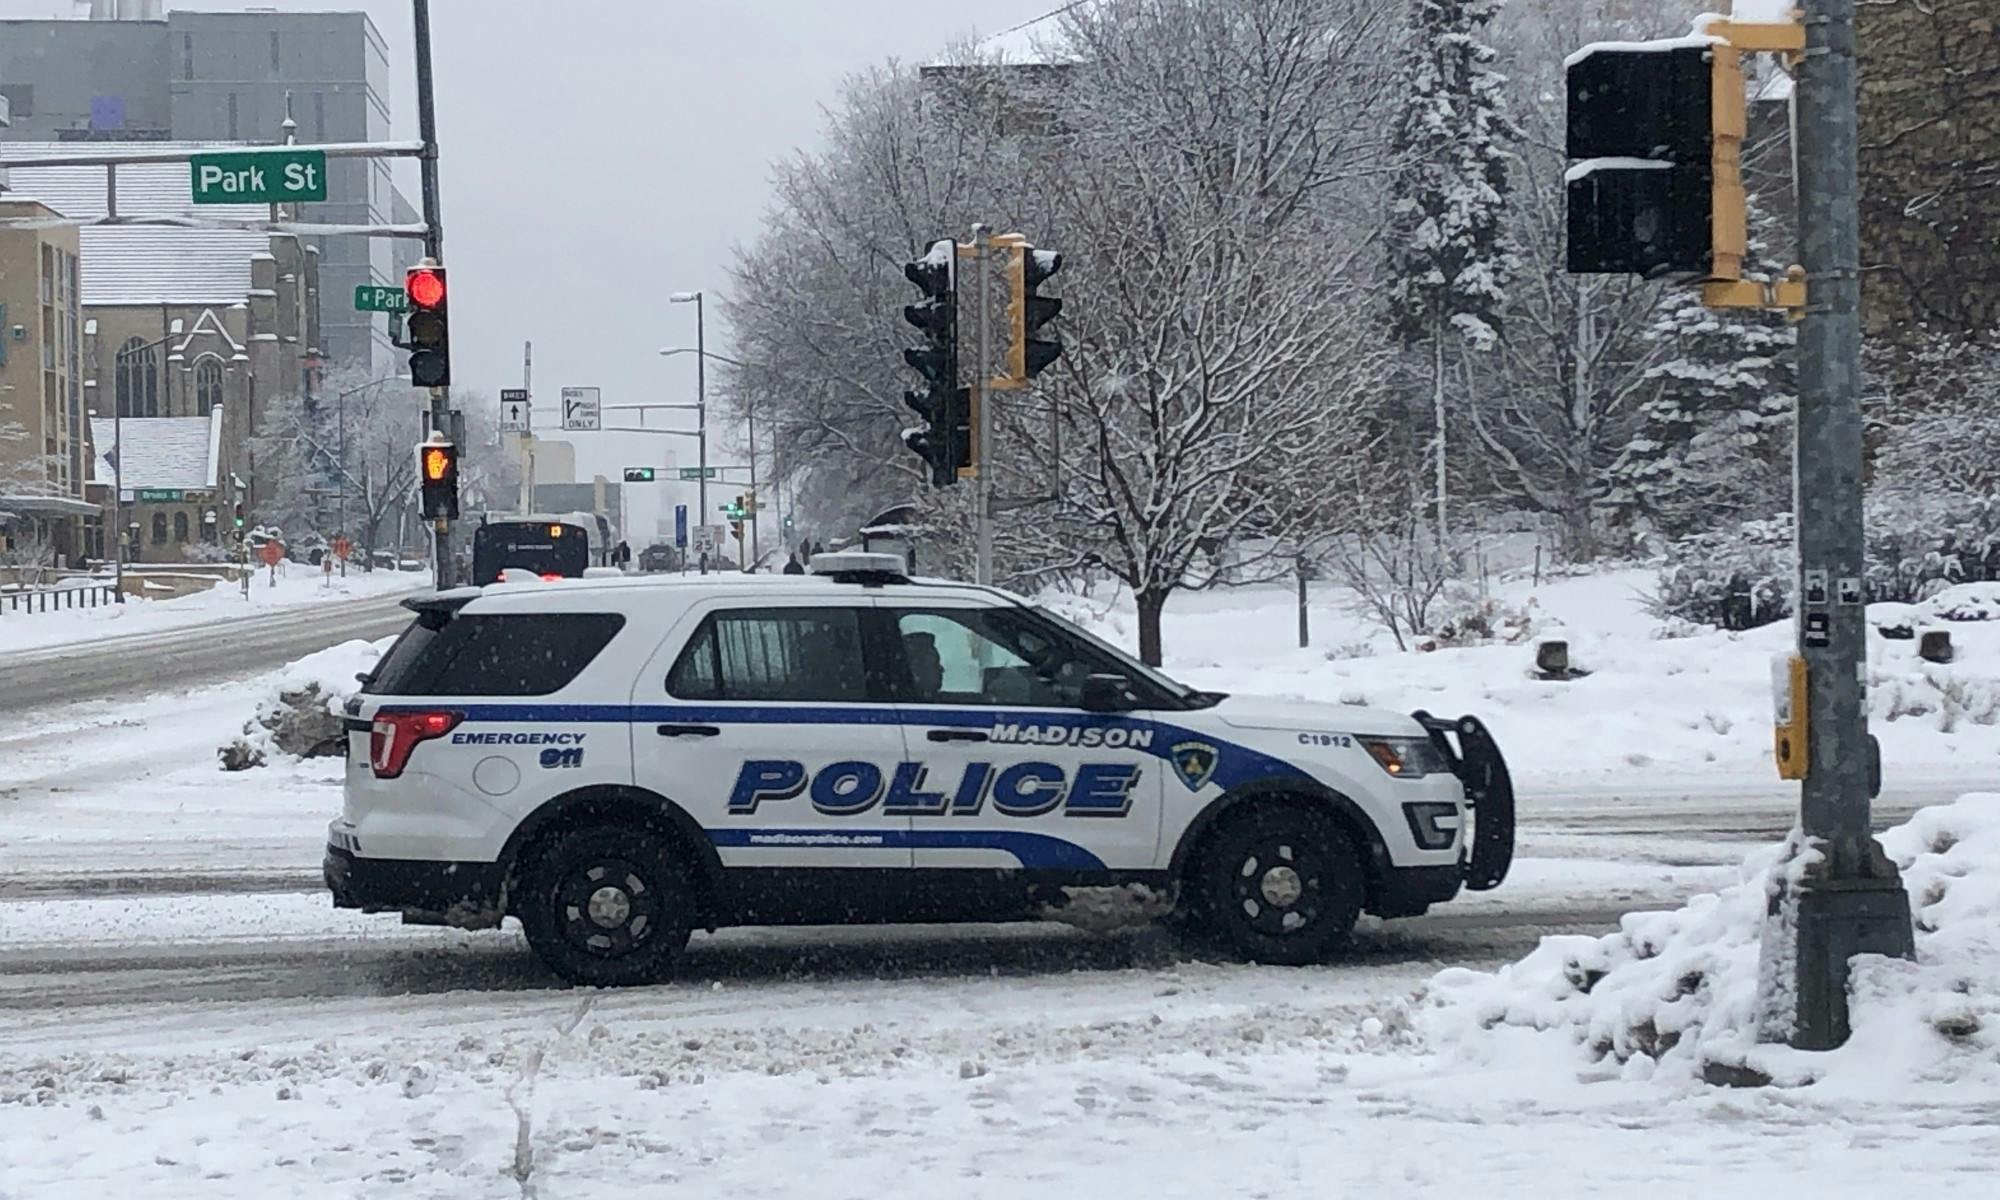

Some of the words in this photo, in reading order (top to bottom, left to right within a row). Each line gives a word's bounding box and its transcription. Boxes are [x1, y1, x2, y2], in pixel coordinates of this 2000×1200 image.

[200, 165, 266, 193] Park
[284, 163, 317, 191] St
[568, 420, 594, 428] ONLY
[694, 540, 713, 551] 25
[451, 732, 587, 745] EMERGENCY
[989, 722, 1154, 749] MADISON
[1297, 733, 1352, 748] C1912
[540, 747, 584, 769] 911
[728, 760, 1142, 817] POLICE
[749, 832, 883, 845] madisonpolice.com
